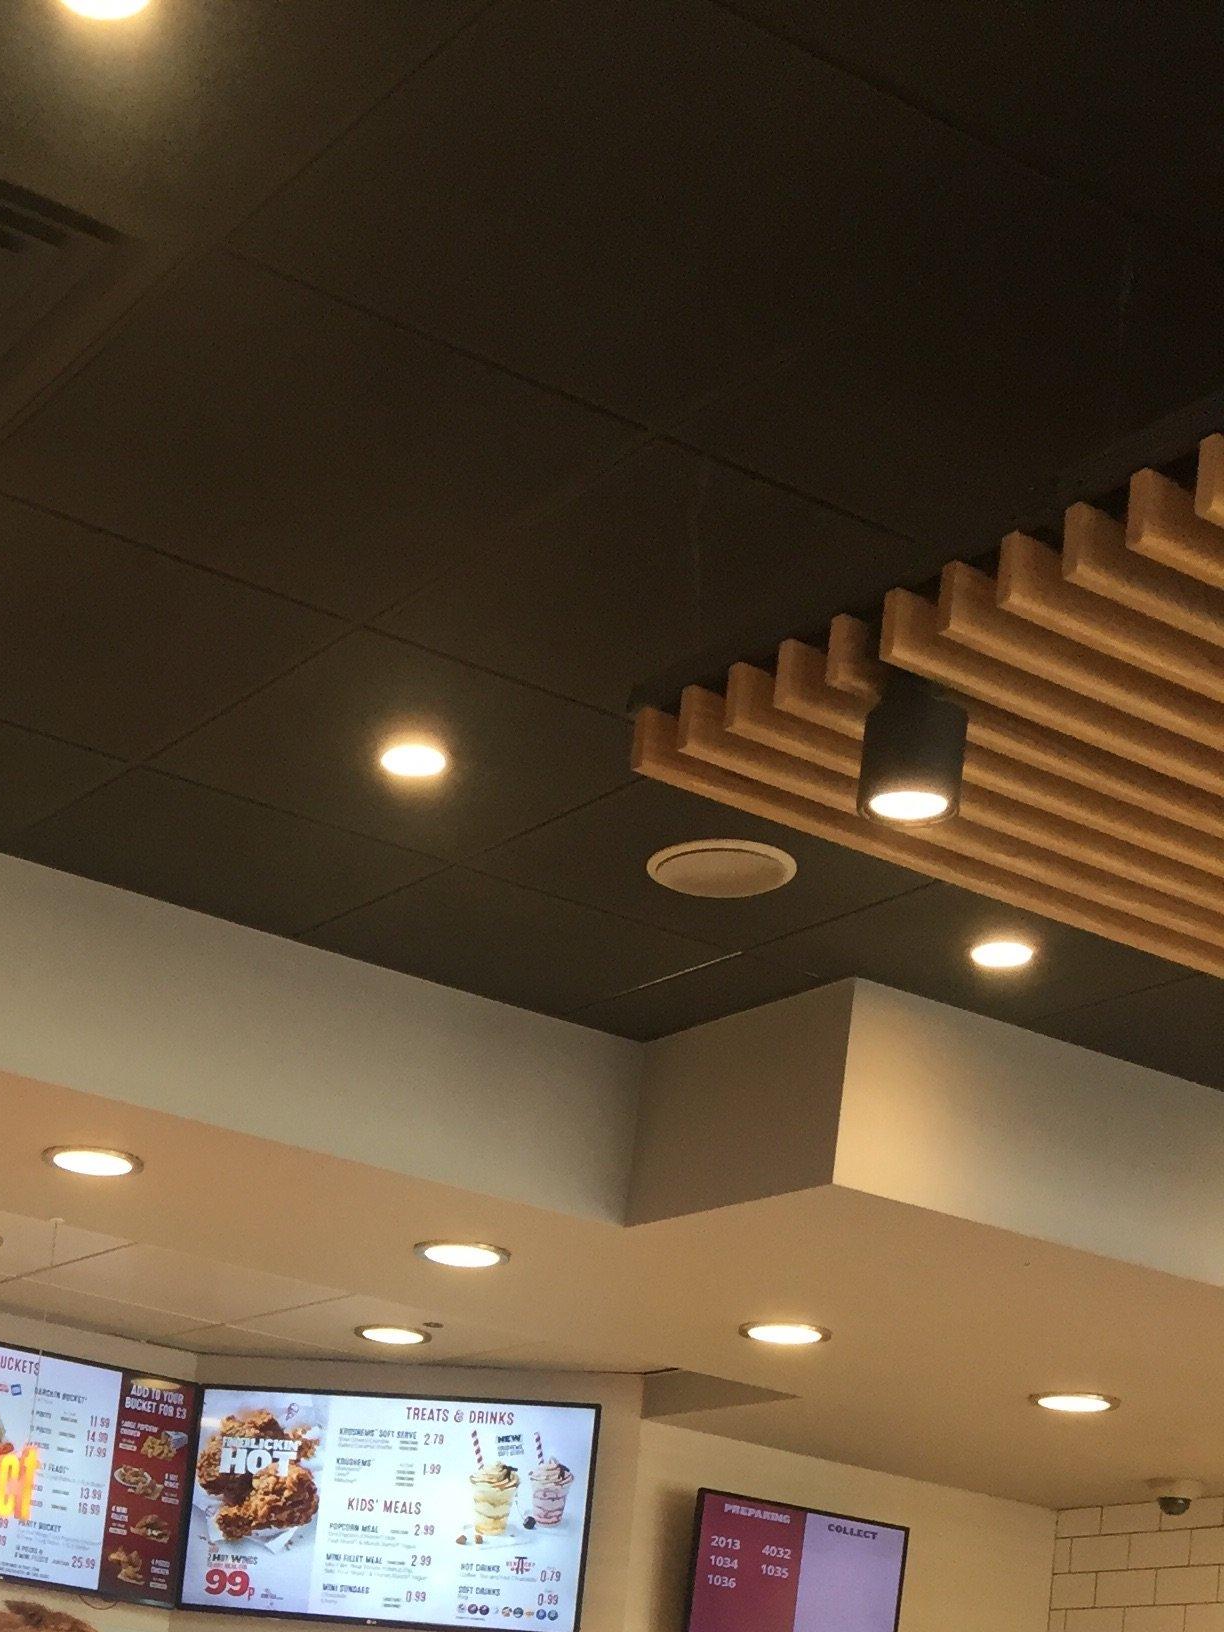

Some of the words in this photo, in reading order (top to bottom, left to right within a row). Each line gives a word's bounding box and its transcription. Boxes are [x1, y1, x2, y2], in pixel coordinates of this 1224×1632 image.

[124, 1396, 157, 1413] BUCKET
[158, 1403, 174, 1417] FOR
[151, 1388, 161, 1400] TO
[163, 1390, 184, 1405] YOUR
[406, 1407, 450, 1423] TREATS
[453, 1410, 464, 1423] &
[469, 1410, 515, 1426] DRINKS
[497, 1434, 522, 1443] NEW
[219, 1447, 298, 1477] HOT
[347, 1497, 379, 1512] KIDS'
[383, 1500, 422, 1516] MEALS
[724, 1503, 791, 1525] PREPARING
[827, 1523, 878, 1540] COLLECT
[710, 1535, 741, 1550] 2013
[762, 1544, 792, 1559] 4032
[709, 1554, 739, 1569] 1034
[761, 1563, 789, 1579] 1035
[204, 1568, 256, 1601] 99p
[707, 1574, 737, 1589] 1036
